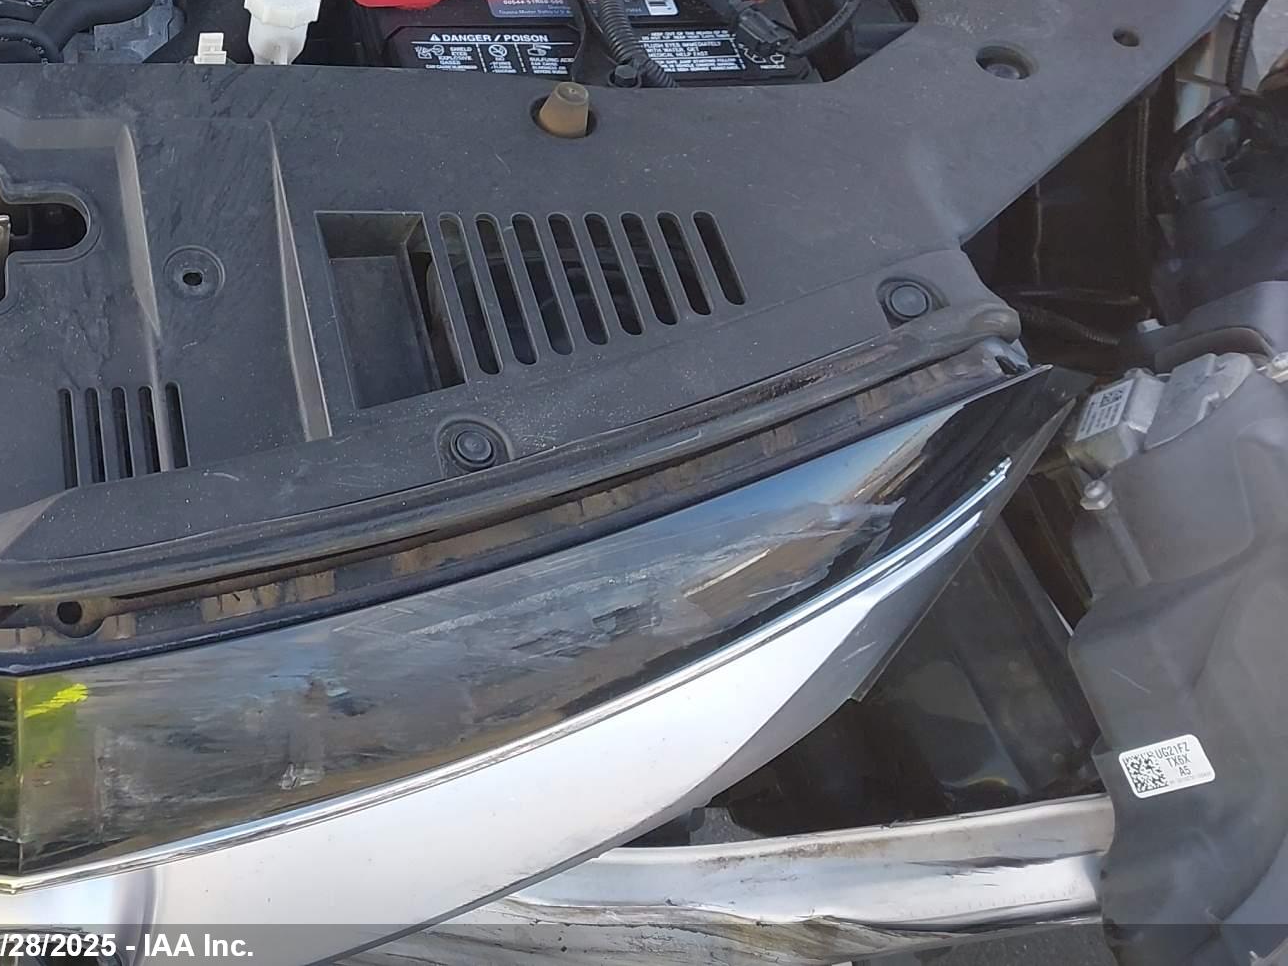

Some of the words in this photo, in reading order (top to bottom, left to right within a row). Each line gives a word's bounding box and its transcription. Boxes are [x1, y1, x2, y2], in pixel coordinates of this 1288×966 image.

[441, 34, 492, 42] DANGER
[494, 34, 502, 42] /
[503, 34, 549, 42] POISON
[1155, 742, 1190, 759] UG21FZ
[1166, 754, 1192, 768] TX6X
[1178, 766, 1192, 777] A5
